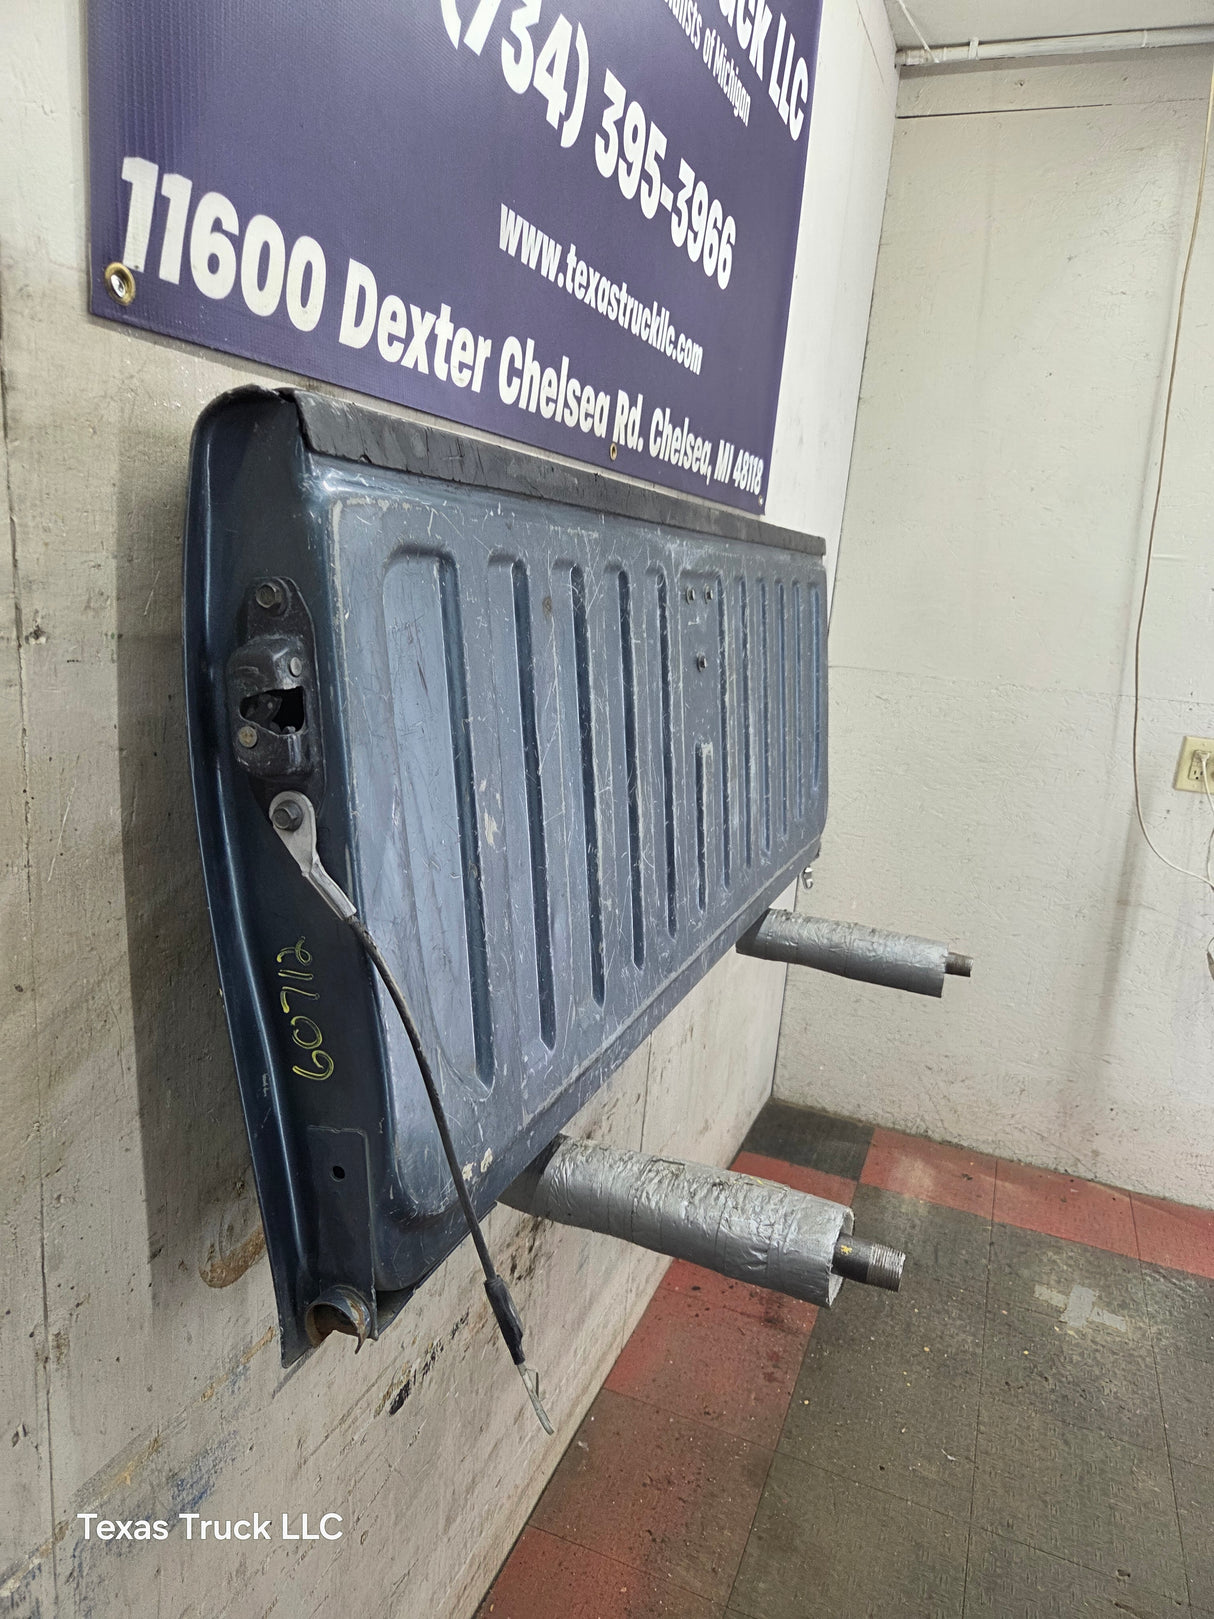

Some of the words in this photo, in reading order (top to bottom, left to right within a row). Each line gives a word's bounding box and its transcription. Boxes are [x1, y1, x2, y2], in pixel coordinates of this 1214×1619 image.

[702, 27, 717, 70] of
[712, 34, 751, 127] Michigan
[768, 12, 809, 141] LLC
[595, 67, 736, 290] 395-3966
[121, 156, 326, 332] 11600
[338, 257, 492, 394] Dexter
[499, 335, 611, 439] Chelsea
[612, 388, 644, 453] Rd.
[649, 407, 712, 486] Chelsea,
[713, 438, 735, 484] MI
[732, 448, 764, 495] 48118
[499, 202, 704, 376] www.texastruckllc.com
[276, 936, 335, 1081] 60712
